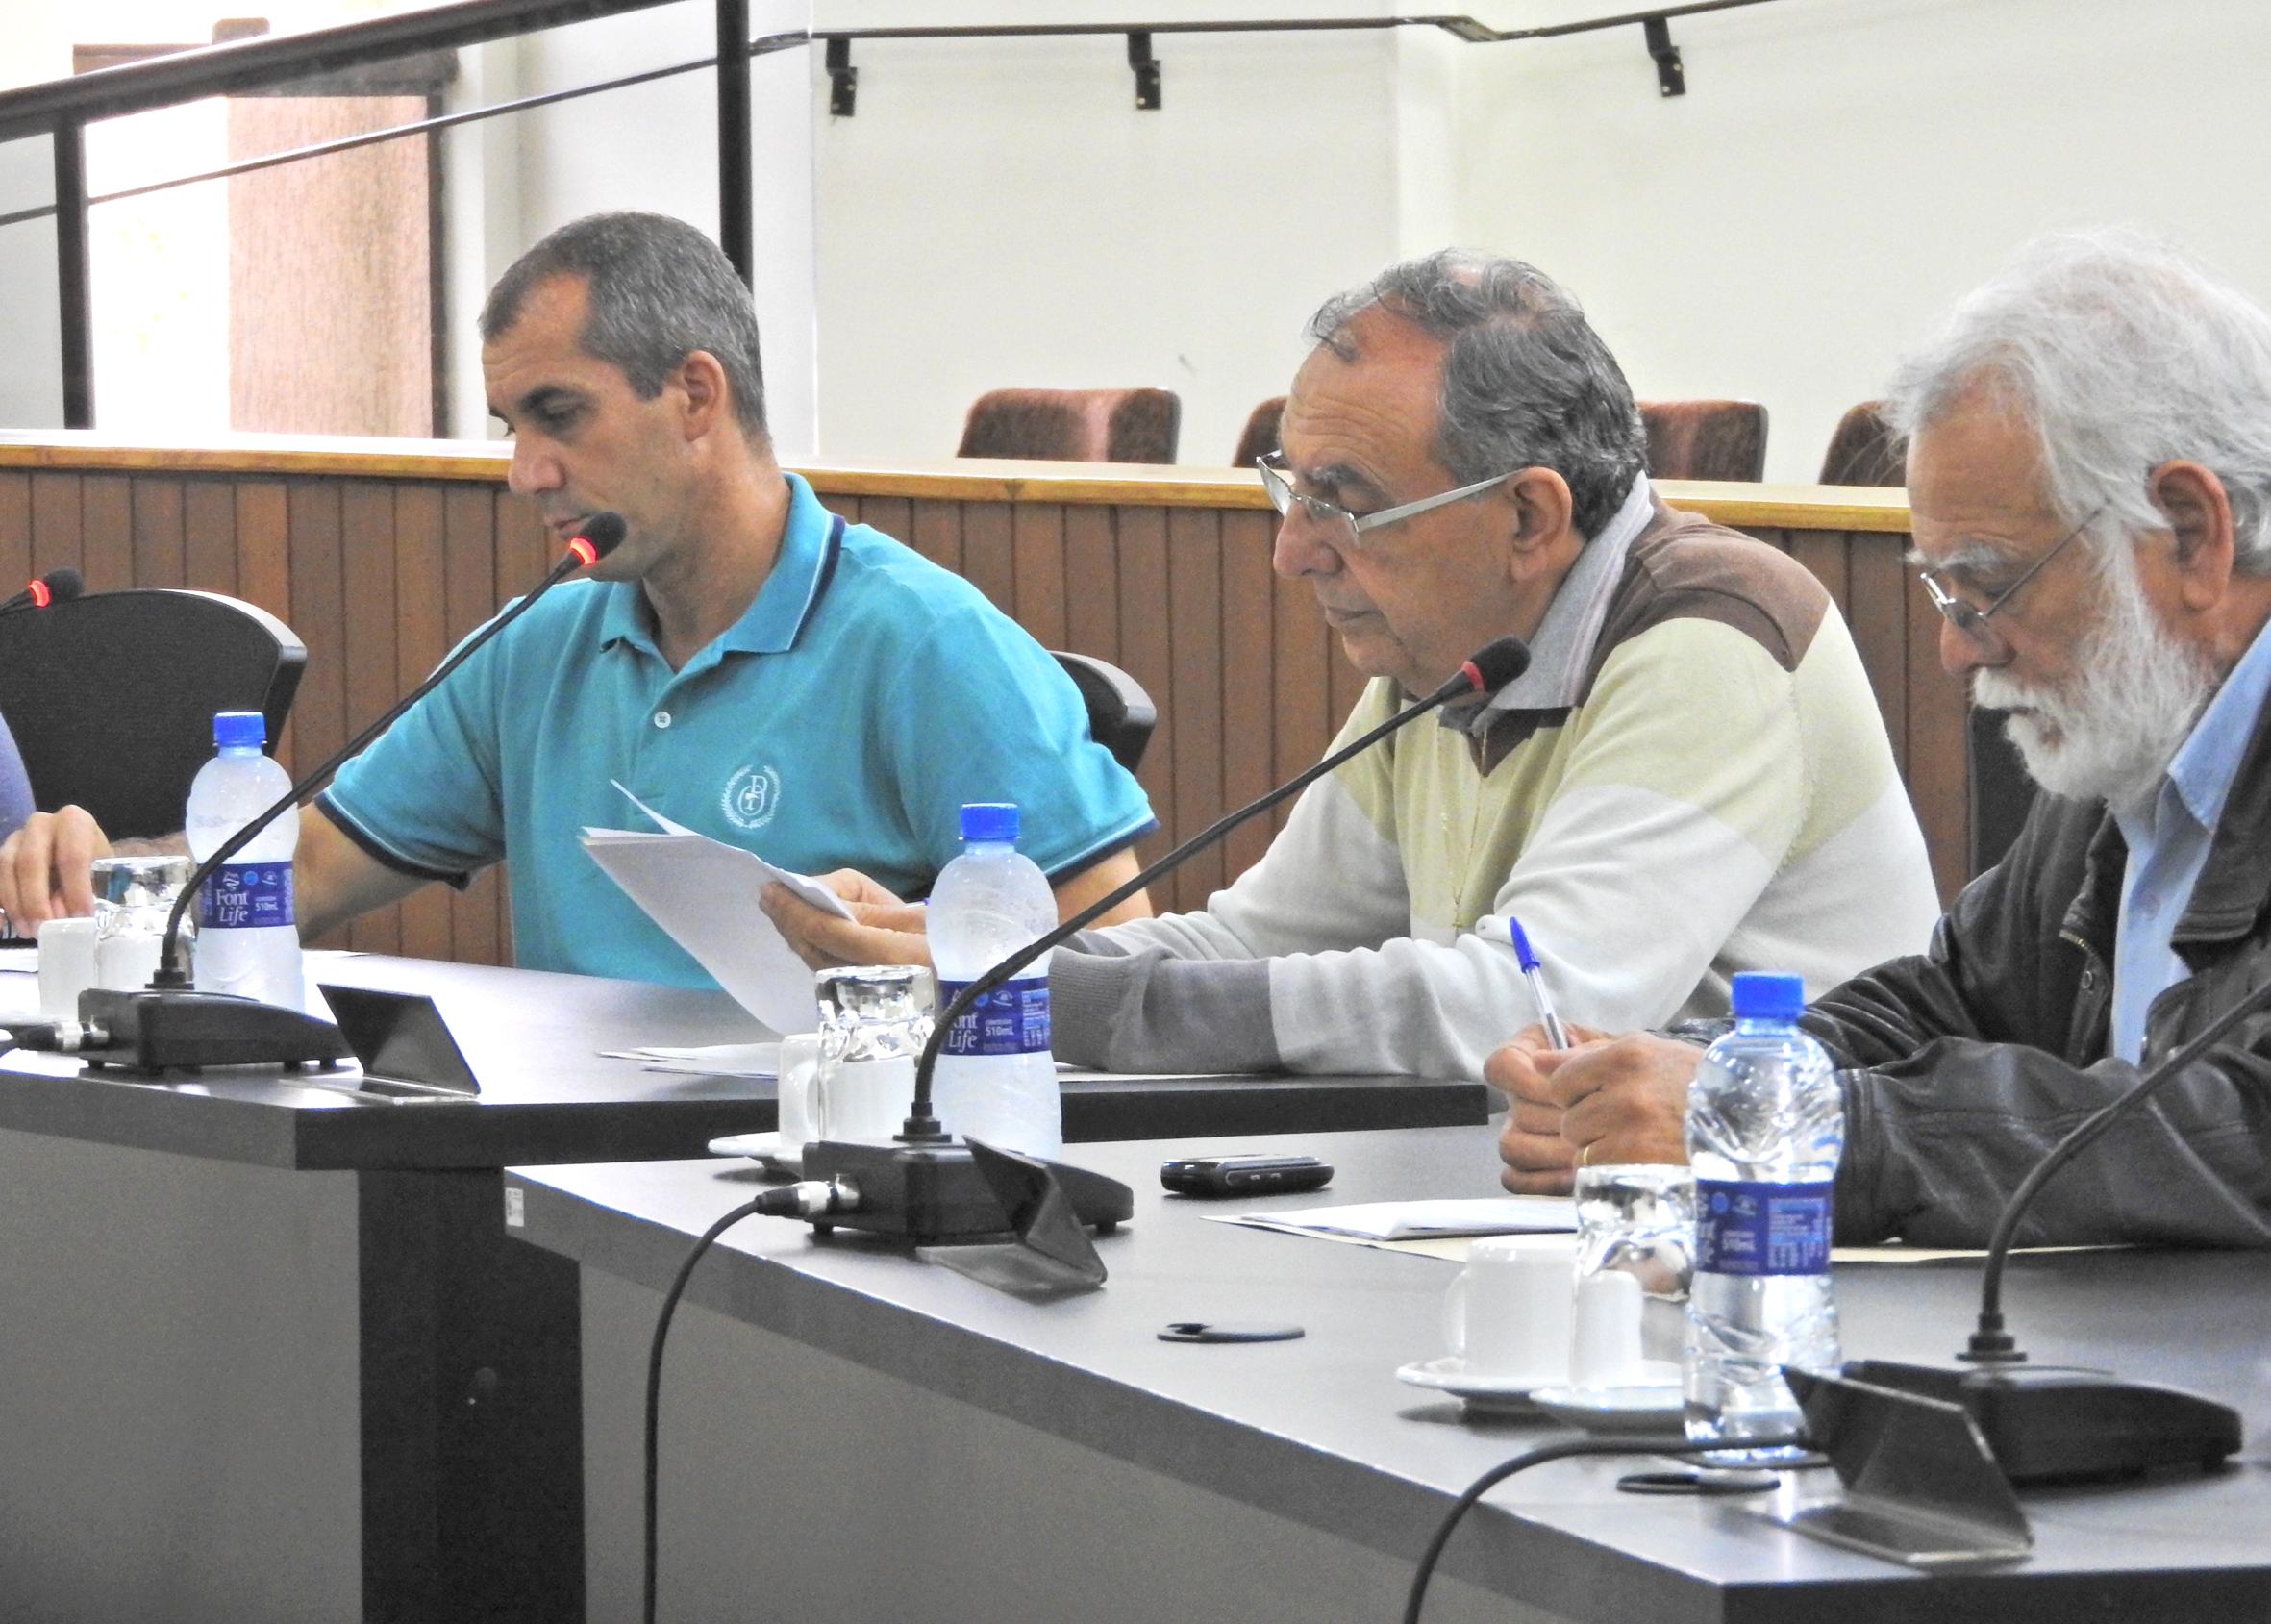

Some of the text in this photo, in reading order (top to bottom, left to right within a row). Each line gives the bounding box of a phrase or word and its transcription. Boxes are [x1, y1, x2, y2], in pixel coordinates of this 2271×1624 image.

[216, 889, 248, 905] Font
[220, 906, 248, 926] Life
[953, 1012, 978, 1029] ont
[986, 1026, 1014, 1036] 510mL
[949, 1030, 978, 1052] Life
